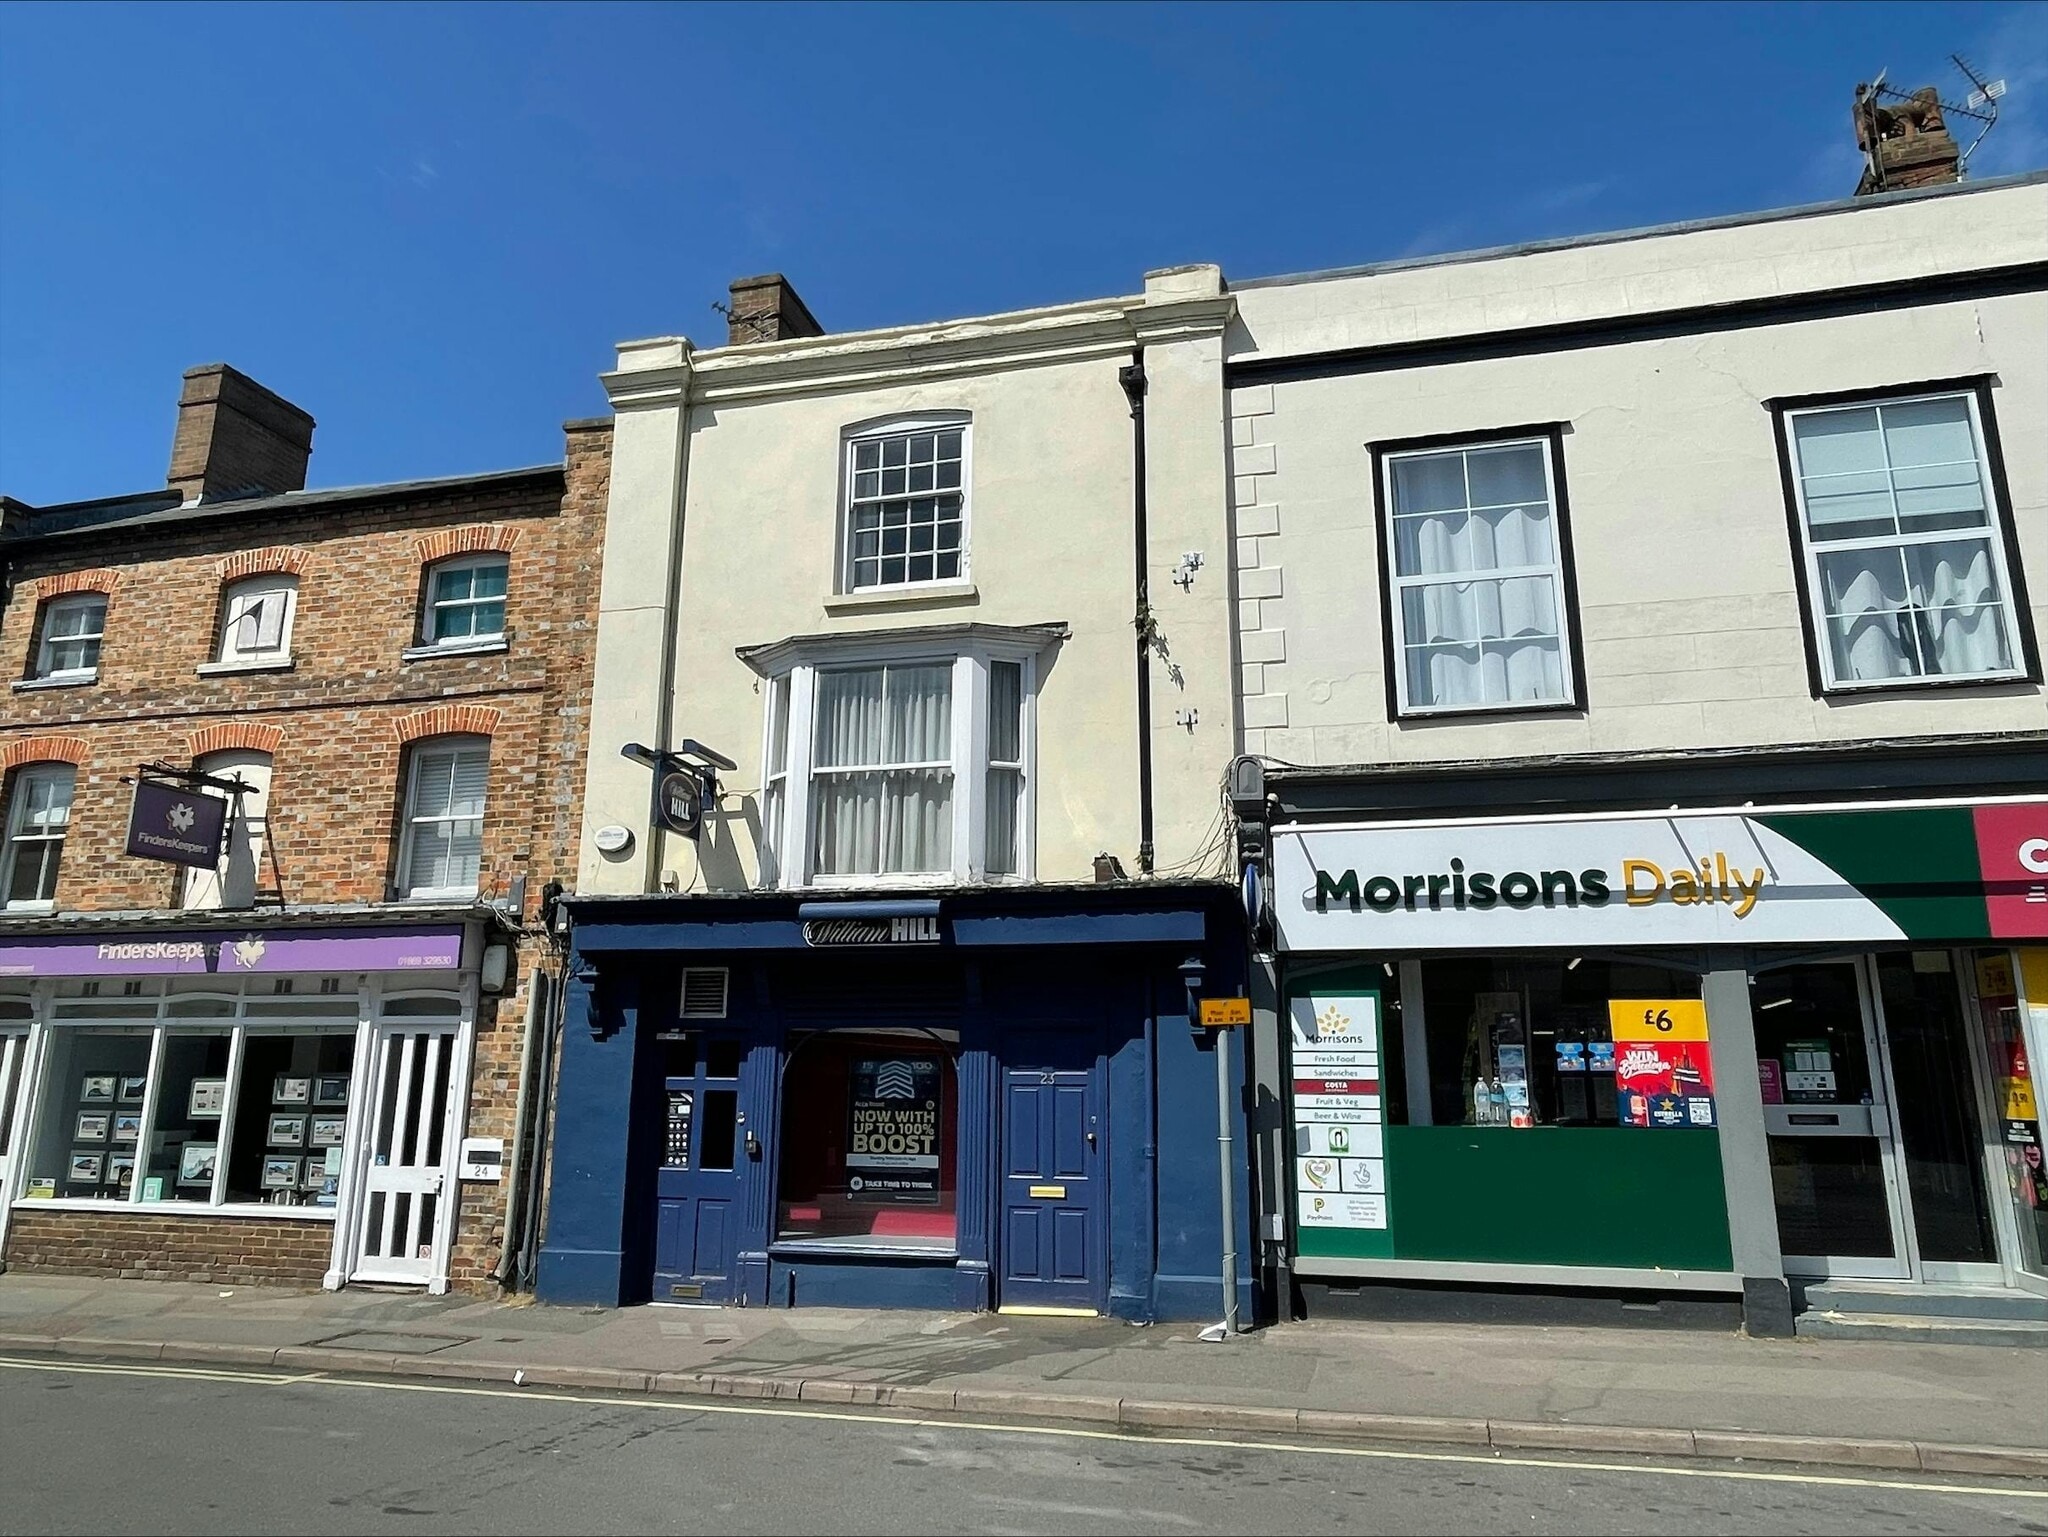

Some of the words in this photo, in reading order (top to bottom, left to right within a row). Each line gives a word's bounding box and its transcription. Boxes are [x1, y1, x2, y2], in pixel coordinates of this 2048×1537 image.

[671, 797, 690, 820] HILL
[137, 831, 208, 854] FindersKeepers
[1316, 857, 1611, 914] Morrisons
[1623, 852, 1763, 920] Daily
[806, 919, 889, 943] William
[891, 917, 940, 942] HILL
[97, 941, 222, 962] FindersKeepers
[1644, 1009, 1673, 1032] £6
[1306, 1030, 1363, 1045] Morrisons
[1315, 1055, 1335, 1063] Fresh
[1336, 1055, 1356, 1063] Food
[1625, 1050, 1659, 1062] WIN
[1040, 1072, 1055, 1085] 23
[1313, 1069, 1358, 1078] Sandwiches
[1325, 1081, 1348, 1089] COSTA
[1343, 1098, 1359, 1108] Veg
[854, 1109, 892, 1122] NOW
[895, 1110, 935, 1123] WITH
[1314, 1112, 1332, 1120] Beer
[853, 1122, 874, 1134] UP
[876, 1122, 895, 1134] TO
[898, 1123, 935, 1135] 100%
[853, 1133, 935, 1154] BOOST
[474, 1165, 488, 1177] 24
